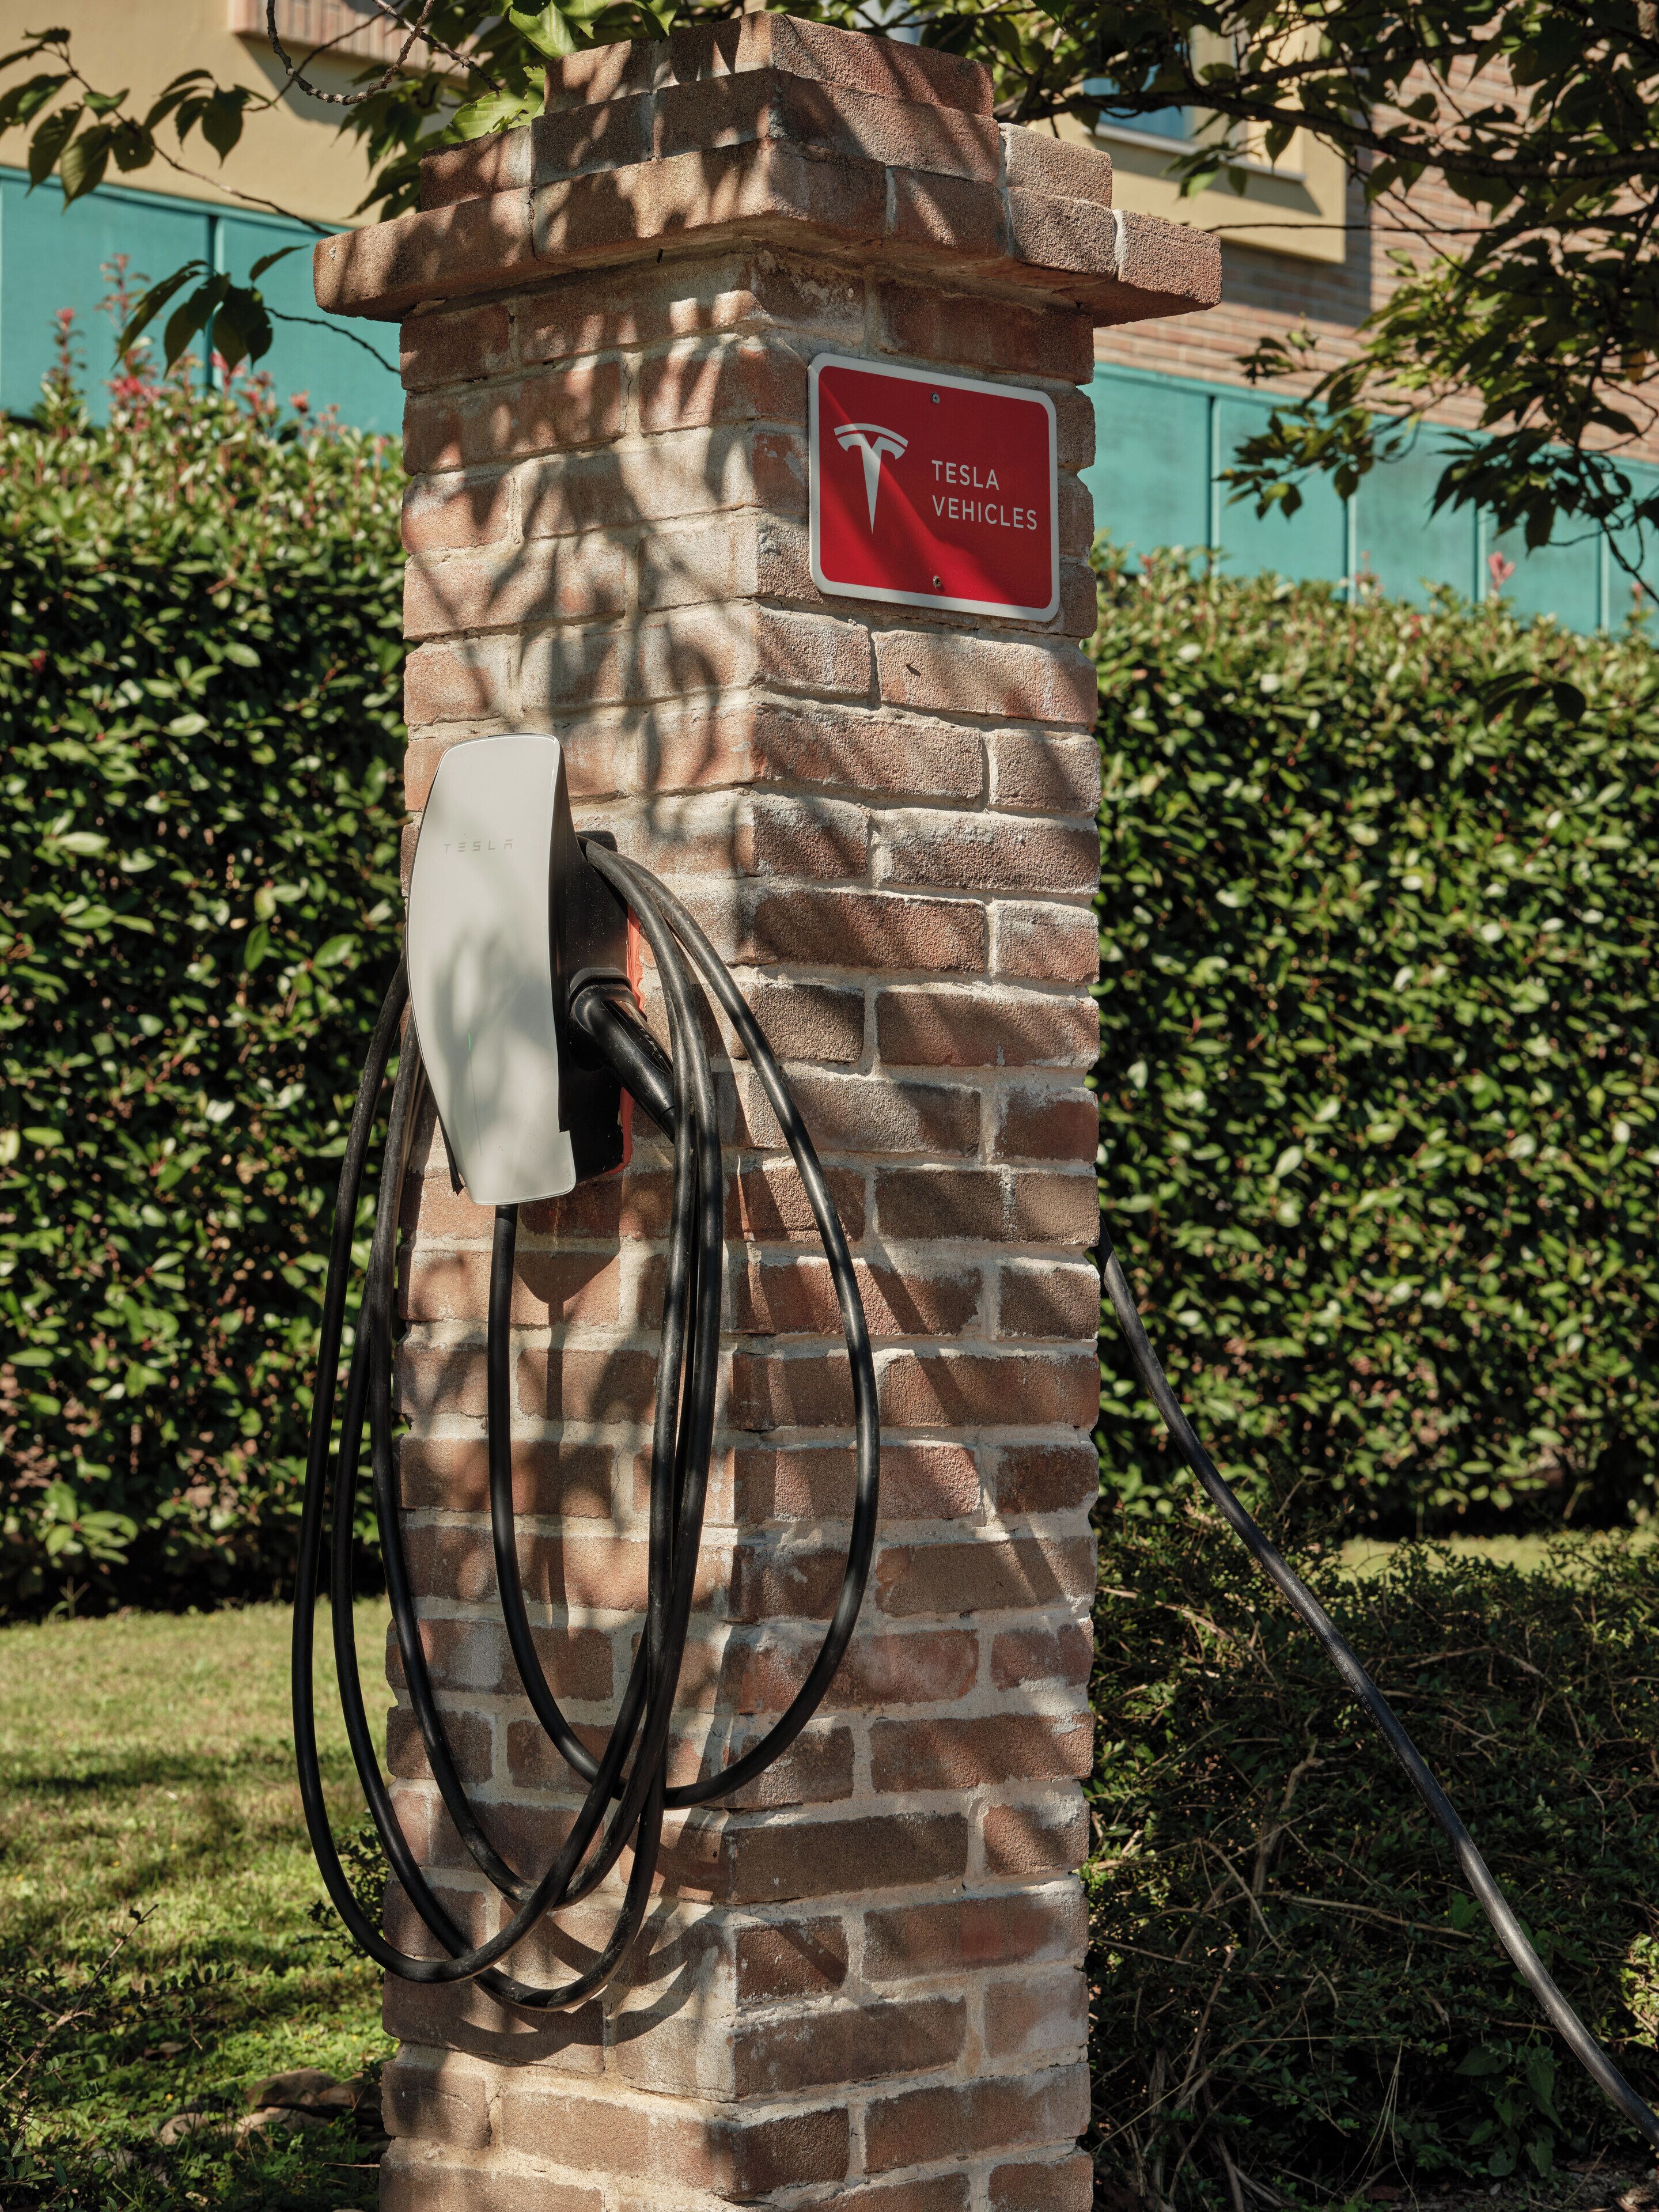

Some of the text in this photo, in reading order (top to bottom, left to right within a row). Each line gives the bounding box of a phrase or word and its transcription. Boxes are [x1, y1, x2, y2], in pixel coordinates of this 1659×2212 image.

[931, 460, 999, 490] TESLA
[932, 495, 1037, 531] VEHICLES
[444, 839, 513, 854] TESLA
[1360, 1695, 1368, 1704] IEC
